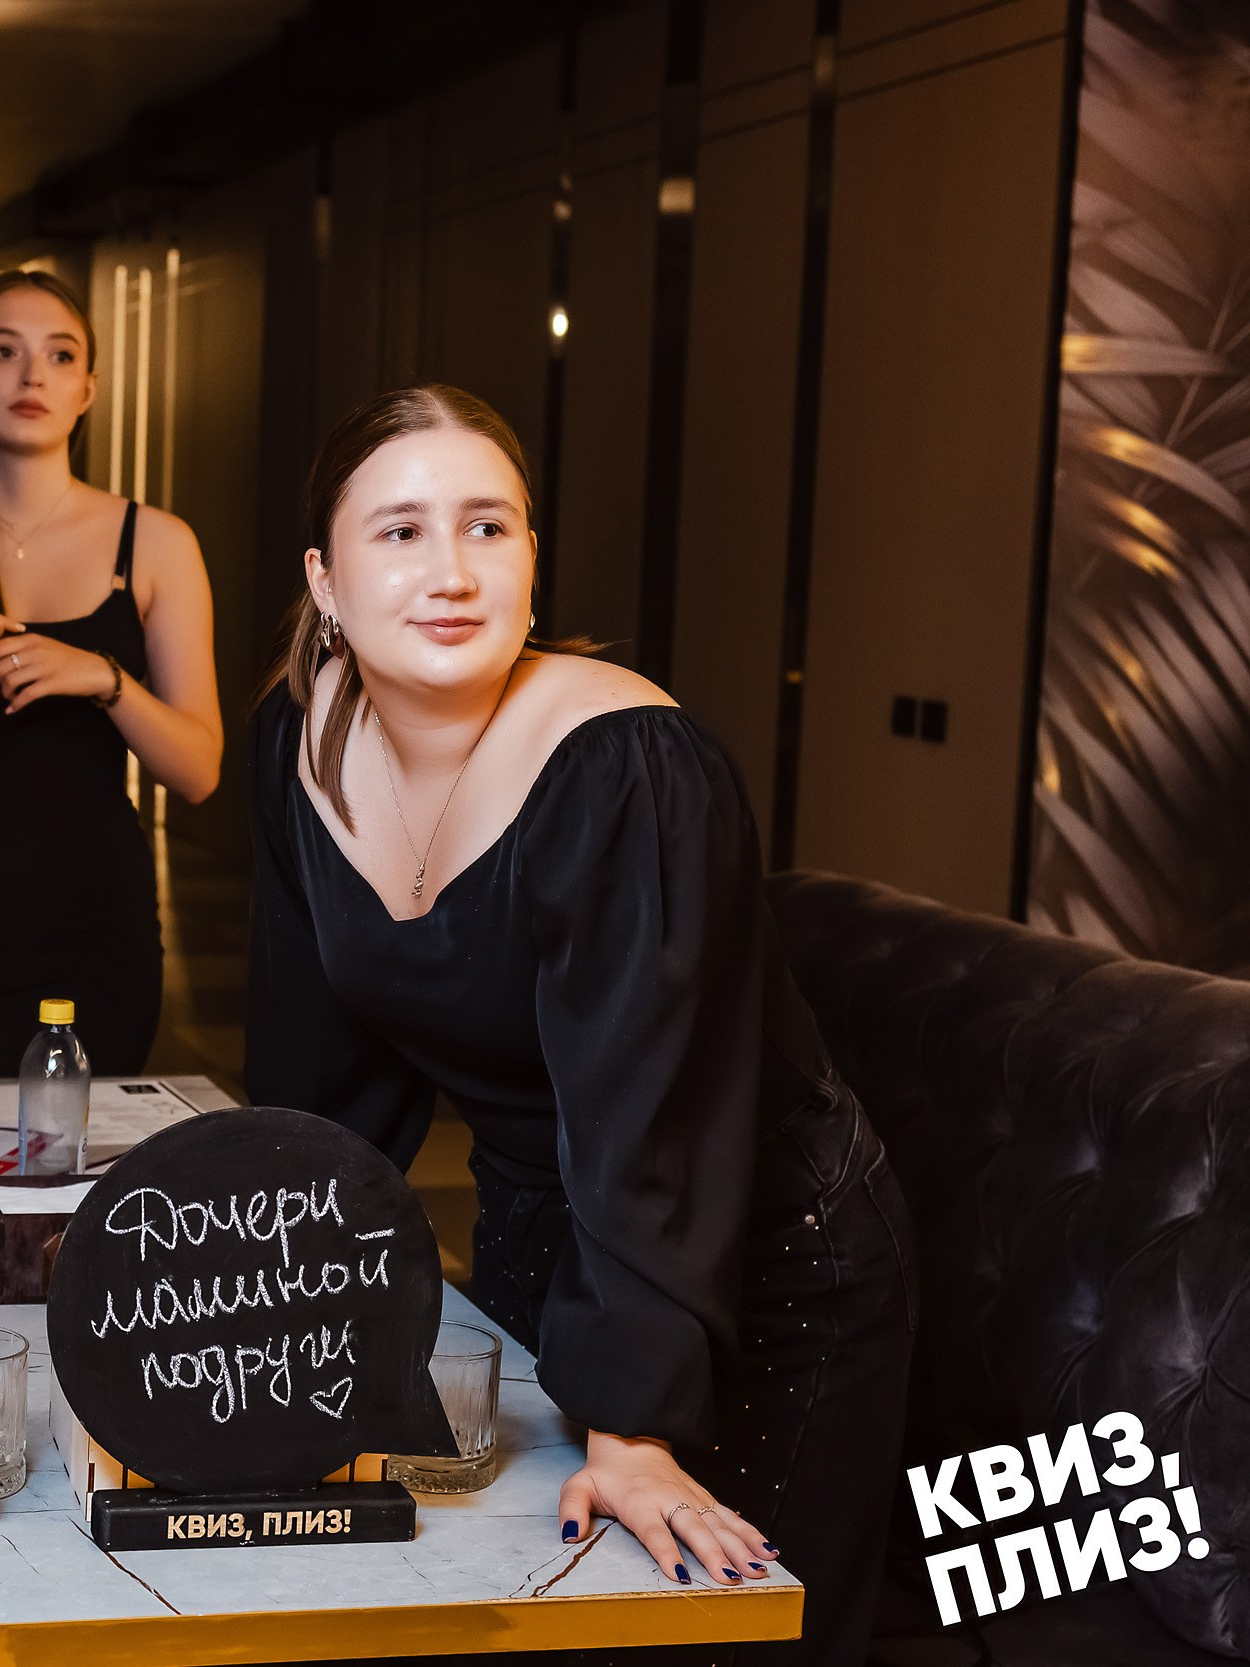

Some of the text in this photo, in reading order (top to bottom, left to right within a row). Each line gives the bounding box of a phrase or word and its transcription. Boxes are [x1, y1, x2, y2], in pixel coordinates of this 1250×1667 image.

[105, 1178, 344, 1268] Дочери
[167, 1509, 352, 1542] КВИЗ, ПЛИЗ!
